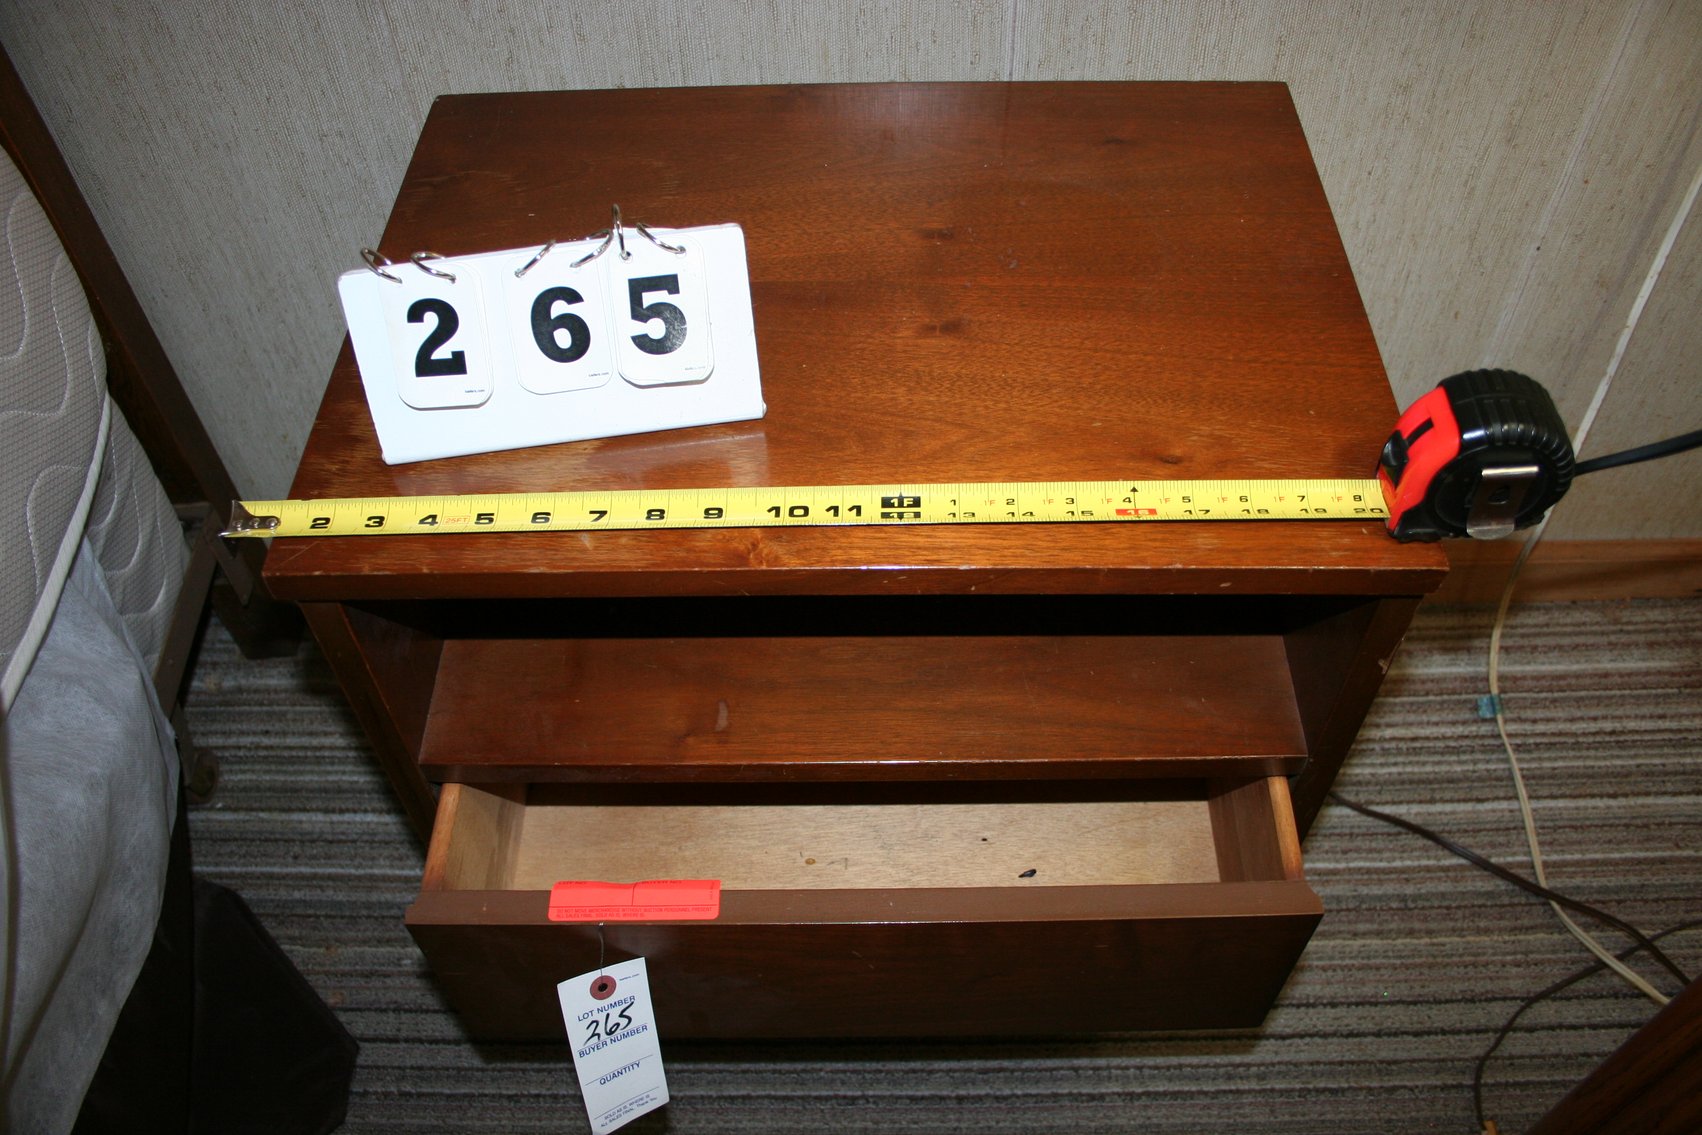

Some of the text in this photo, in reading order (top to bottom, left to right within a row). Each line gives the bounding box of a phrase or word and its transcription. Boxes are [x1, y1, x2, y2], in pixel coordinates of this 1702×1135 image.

[407, 274, 687, 377] 2 6 5
[1006, 498, 1015, 506] 2
[1065, 497, 1075, 505] 3
[309, 517, 331, 529] 2
[364, 515, 385, 528] 3
[418, 514, 439, 526] 4
[474, 513, 495, 525] 5
[531, 511, 552, 524] 6
[588, 510, 608, 522] 7
[645, 508, 666, 521] 8
[703, 507, 724, 519] 9
[766, 505, 810, 518] 10
[825, 505, 862, 517] 11
[577, 995, 636, 1022] LOT NUMBER
[583, 1001, 635, 1047] 265
[578, 1024, 648, 1058] BUYER NUMBER
[599, 1061, 641, 1086] QUANTITY
